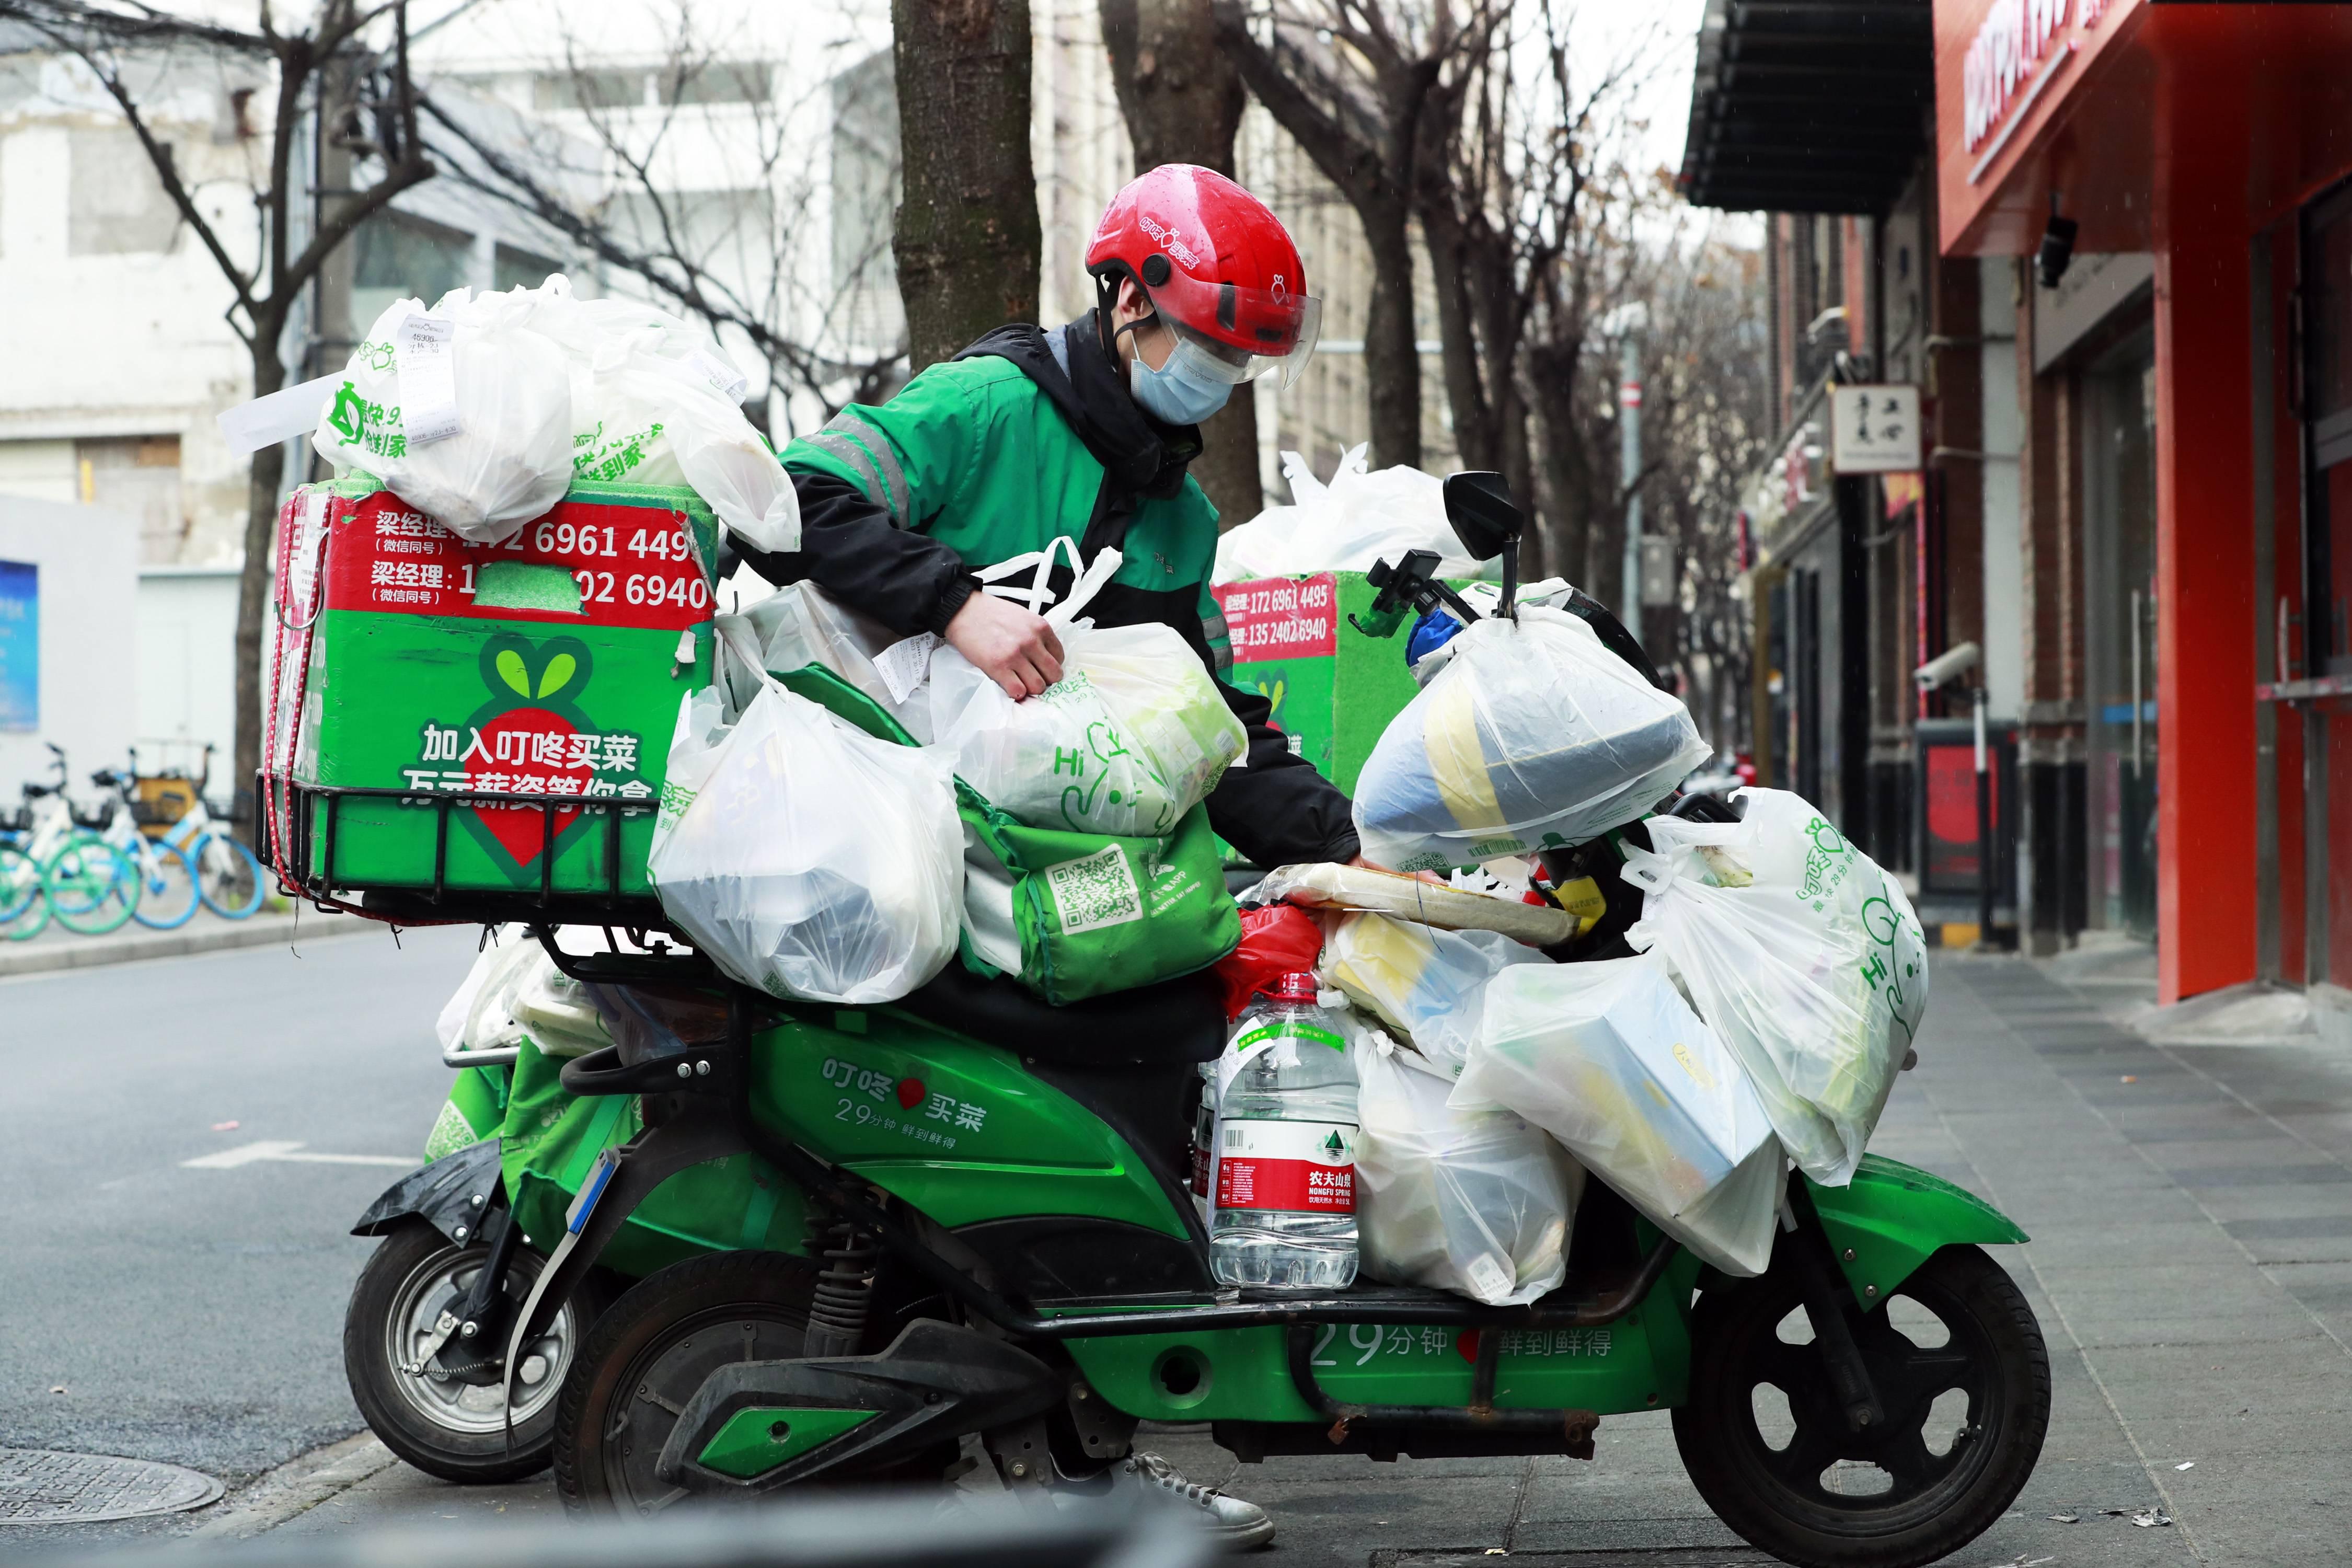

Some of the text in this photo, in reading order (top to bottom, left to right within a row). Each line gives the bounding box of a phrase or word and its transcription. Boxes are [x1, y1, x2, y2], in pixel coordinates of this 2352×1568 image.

[1139, 217, 1200, 270] 叮咚 买菜
[535, 522, 617, 557] 6961
[628, 528, 694, 562] 449
[626, 574, 707, 609] 6940
[1250, 591, 1270, 614] 172
[1272, 589, 1298, 612] 6961
[1301, 585, 1328, 608] 4495
[1249, 623, 1267, 645] 135
[1270, 621, 1297, 644] 2402
[1299, 618, 1326, 641] 6940
[422, 724, 638, 772] 加入叮咚买菜
[1054, 746, 1084, 777] Hi
[1860, 952, 1888, 990] Hi
[822, 1058, 987, 1132] 叮咚 买菜
[901, 1124, 956, 1149] 鲜到鲜得
[1309, 1171, 1351, 1187] 农夫山泉
[1309, 1187, 1334, 1196] NONGFU
[1498, 1328, 1612, 1357] 鲜到鲜得
